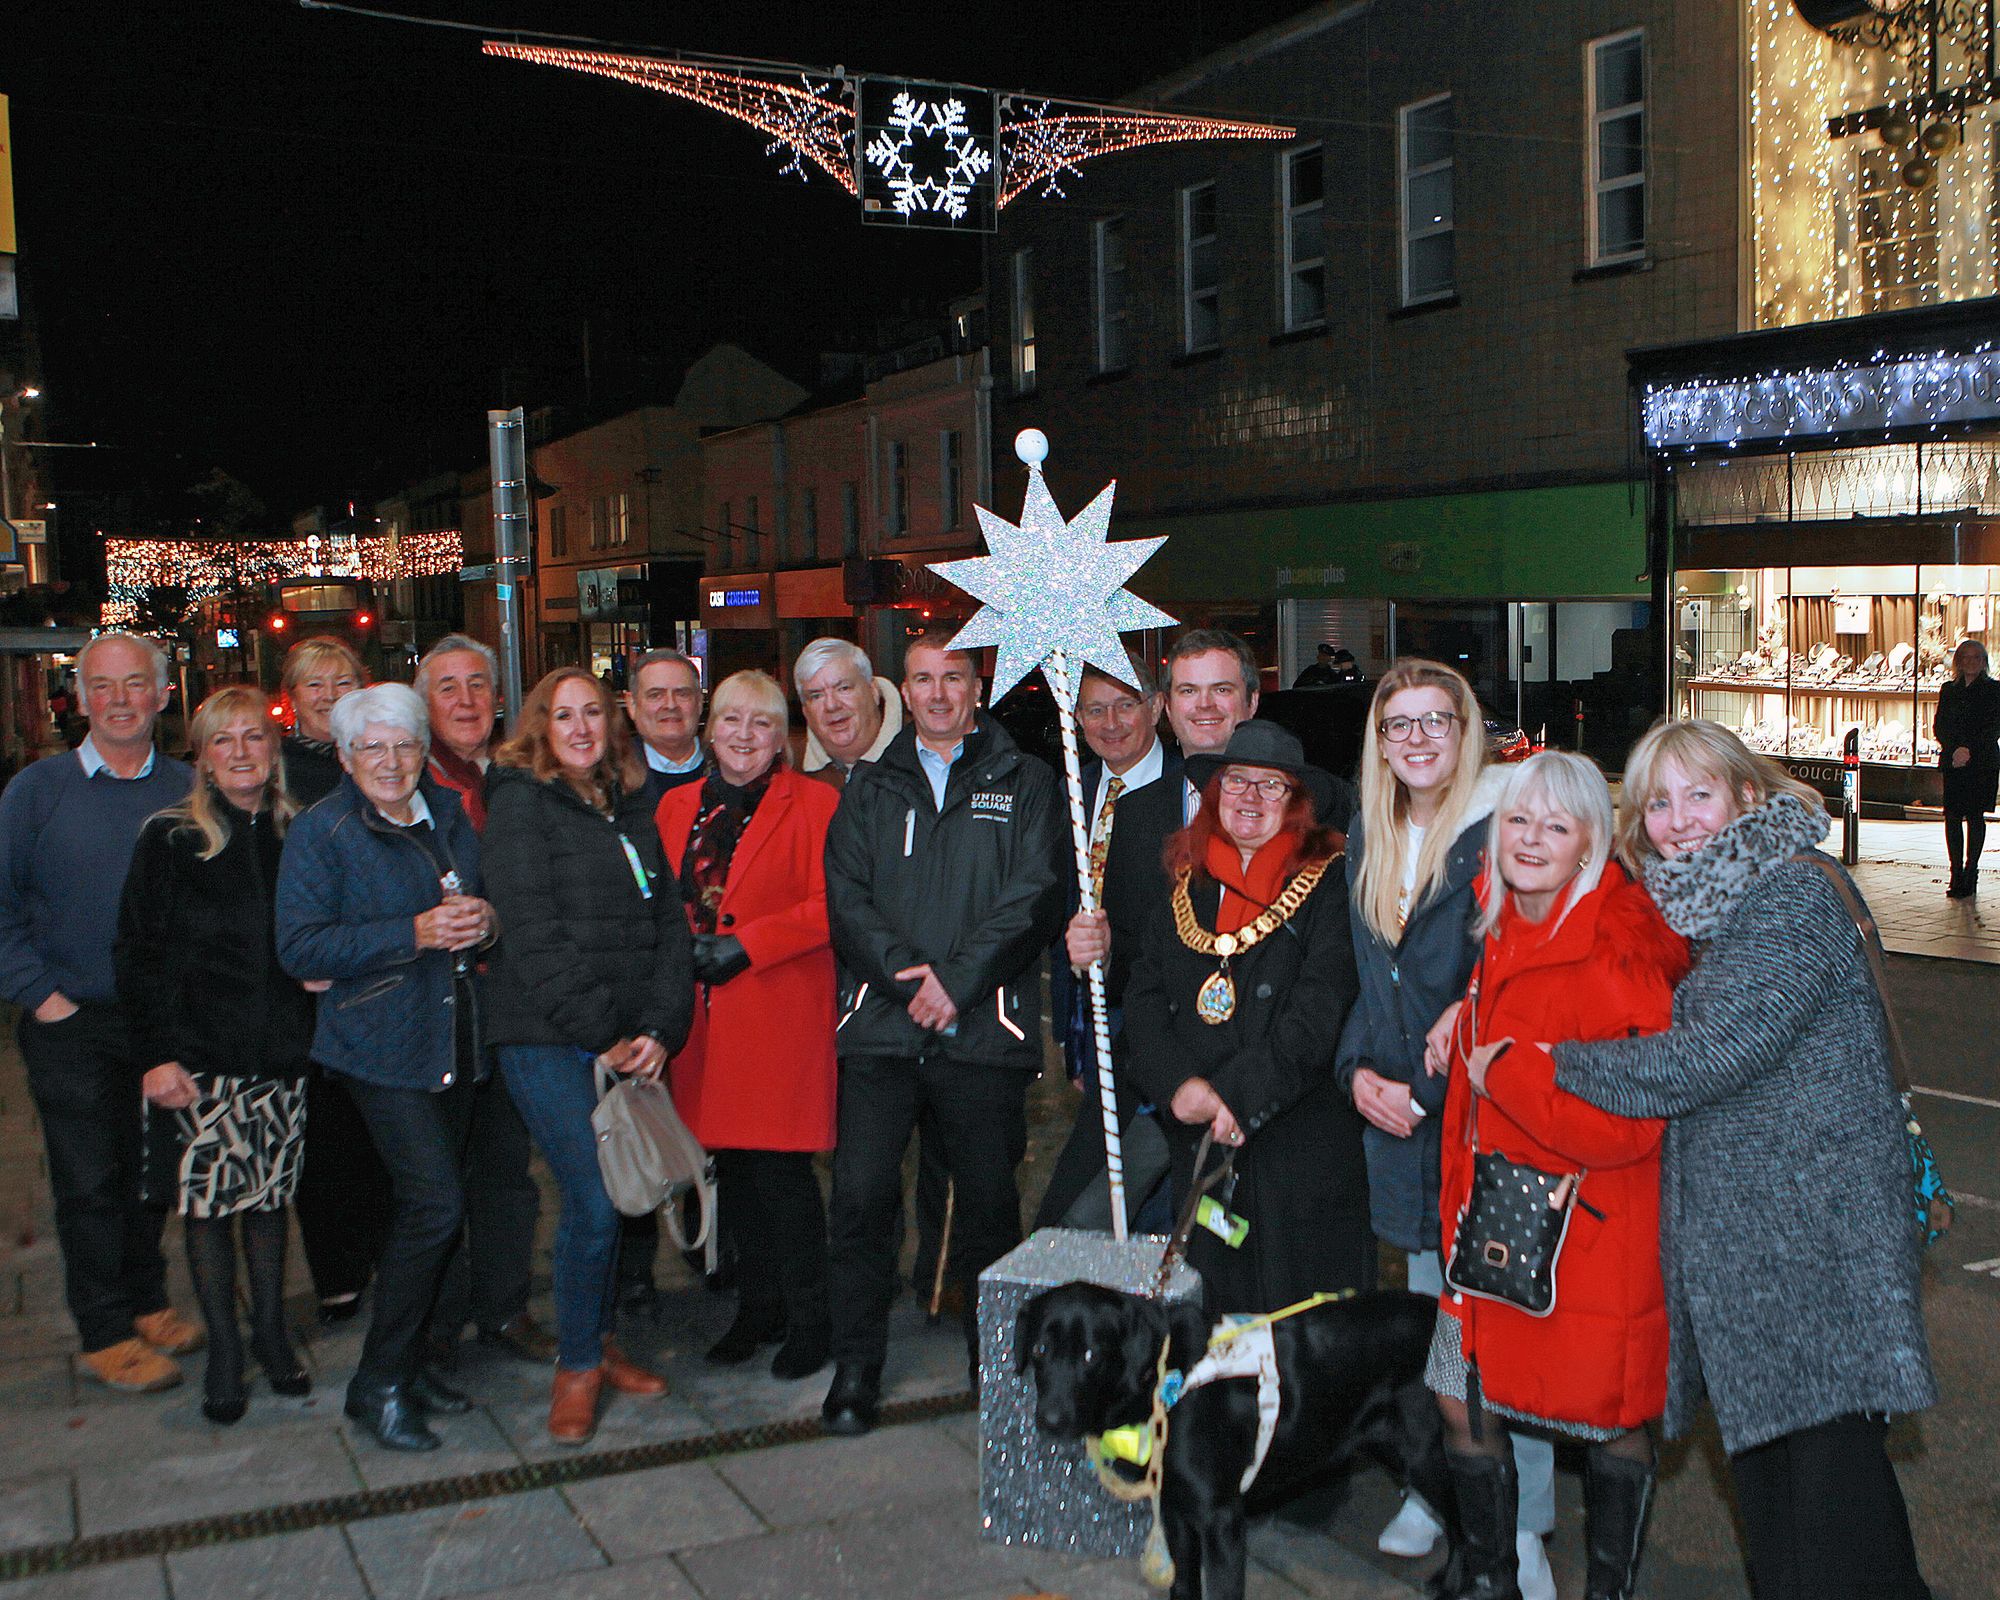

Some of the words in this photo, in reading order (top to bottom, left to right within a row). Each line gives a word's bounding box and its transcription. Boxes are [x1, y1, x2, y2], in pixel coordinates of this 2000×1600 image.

[1744, 383, 1886, 424] CONROY
[710, 591, 725, 607] CASH
[726, 590, 760, 606] GENERATOR
[1788, 765, 1845, 781] COUCH
[972, 793, 1013, 803] UNION
[971, 801, 1012, 812] SQUARE
